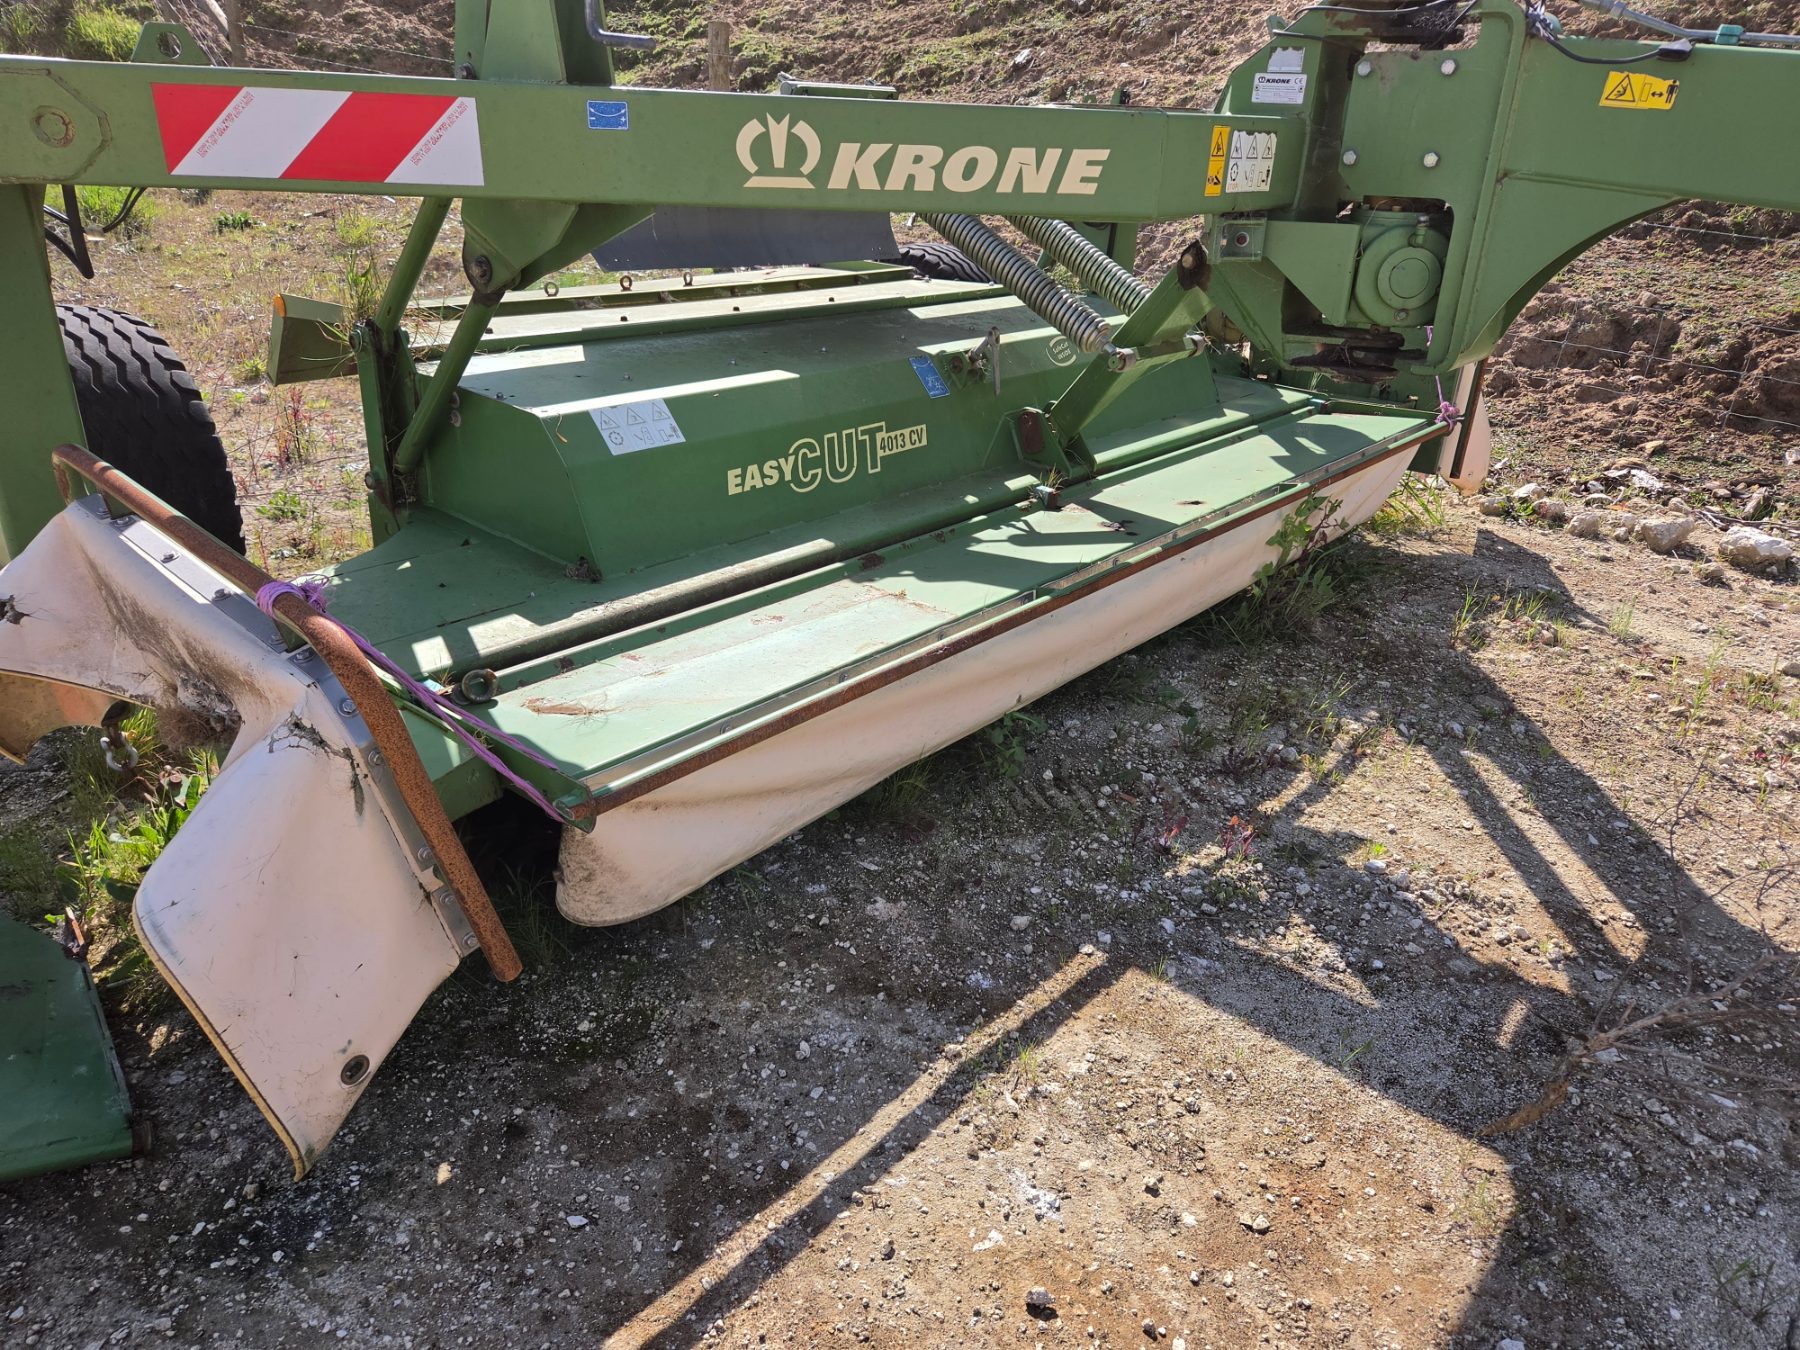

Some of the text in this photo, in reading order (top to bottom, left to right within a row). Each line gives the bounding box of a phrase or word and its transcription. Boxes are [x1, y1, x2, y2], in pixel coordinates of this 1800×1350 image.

[827, 142, 1110, 195] KRONE
[1052, 341, 1069, 354] SafeCut
[879, 433, 907, 454] 4013
[908, 426, 925, 446] CV
